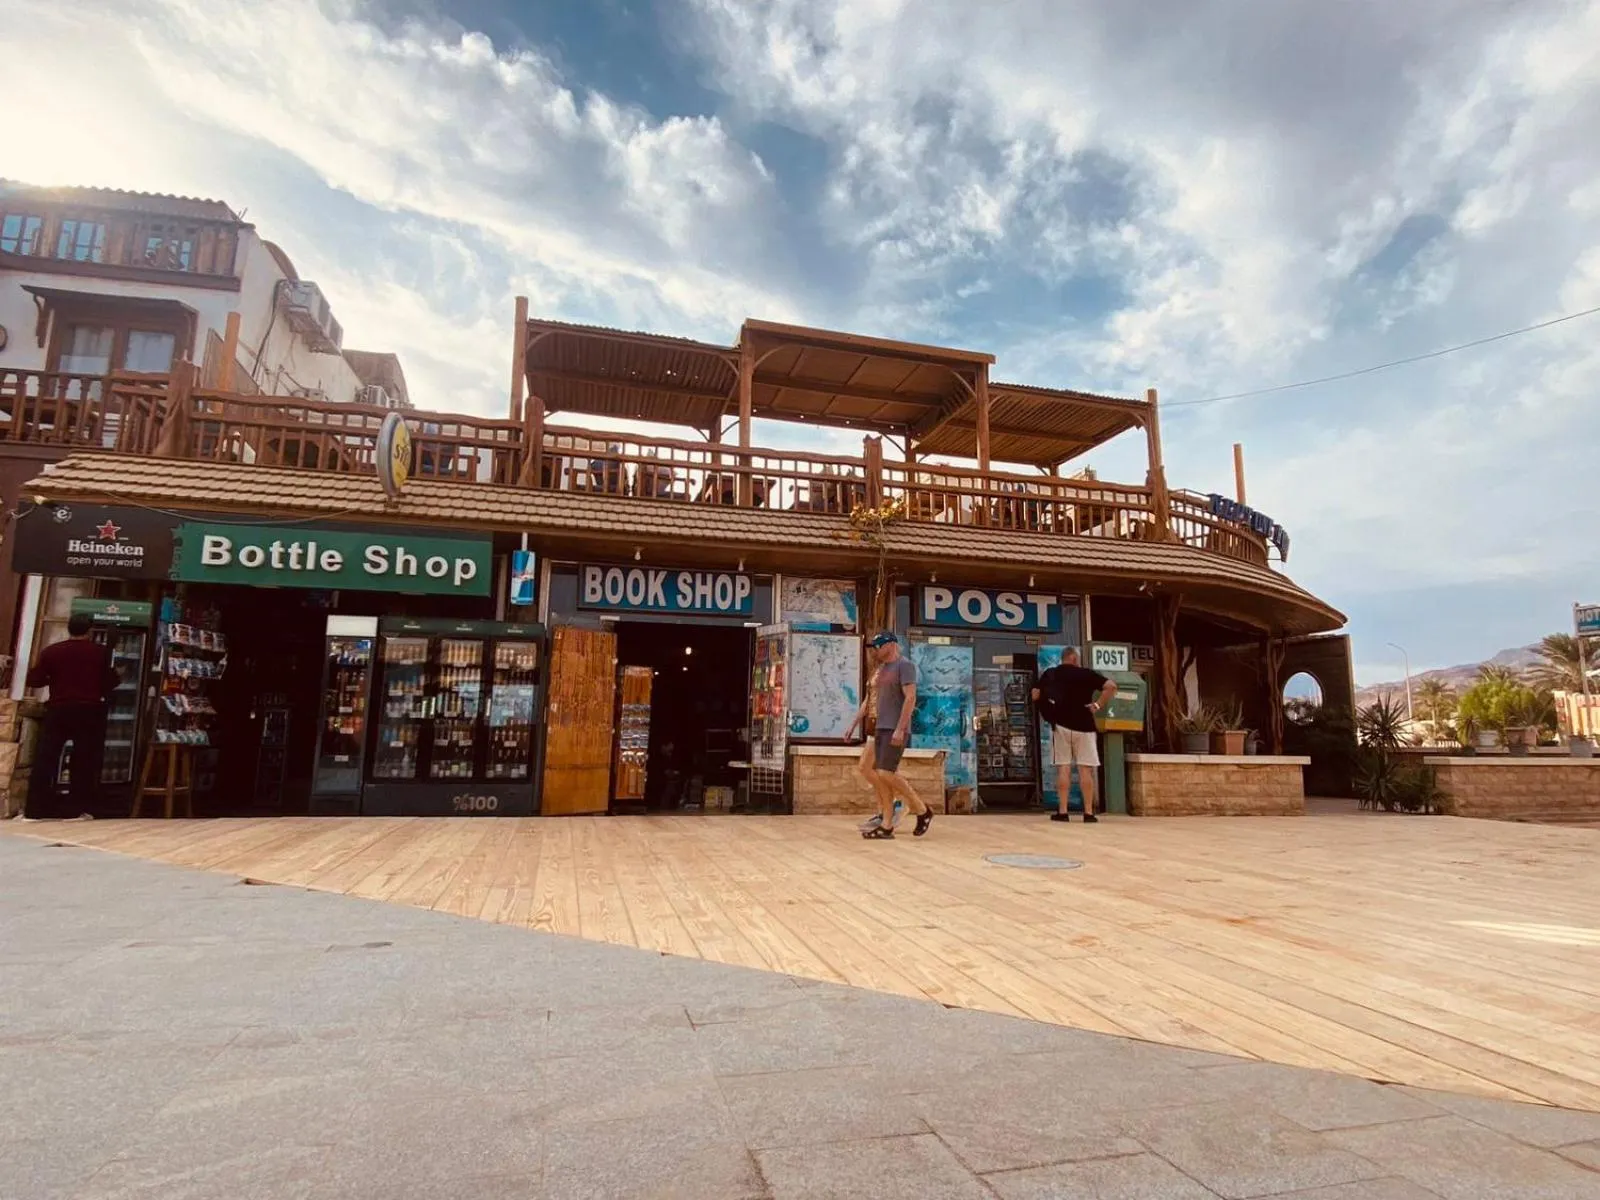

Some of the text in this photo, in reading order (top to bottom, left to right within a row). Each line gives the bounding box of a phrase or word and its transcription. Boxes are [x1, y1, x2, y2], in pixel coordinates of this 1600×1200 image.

[66, 556, 143, 568] open your world
[68, 540, 144, 556] Heineken
[201, 534, 343, 572] Bottle
[362, 545, 477, 586] Shop
[584, 565, 751, 611] BOOK SHOP
[924, 586, 1057, 627] POST
[1095, 649, 1125, 665] POST
